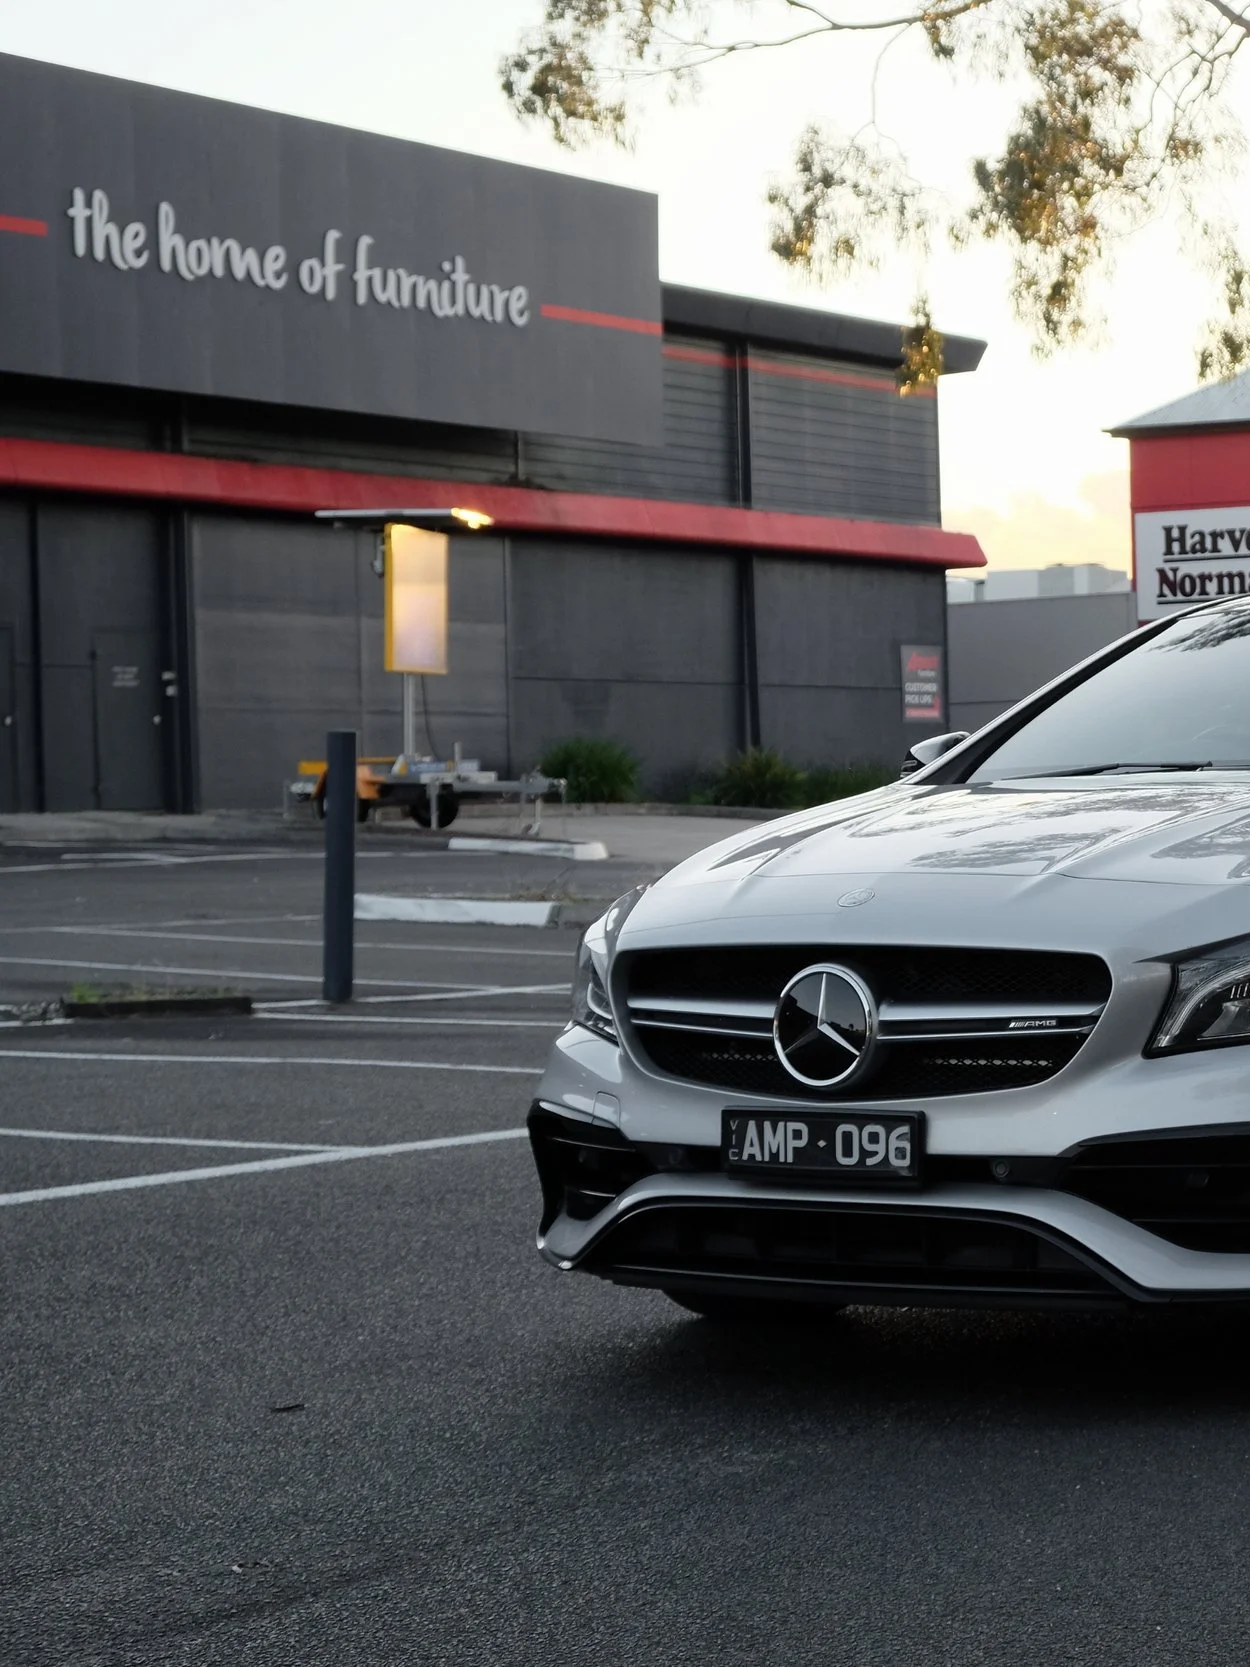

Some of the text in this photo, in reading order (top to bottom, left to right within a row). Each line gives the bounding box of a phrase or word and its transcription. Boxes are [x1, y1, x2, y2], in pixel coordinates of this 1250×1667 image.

[68, 186, 531, 327] the home of furniture
[1023, 1019, 1057, 1028] AMG
[741, 1119, 912, 1167] AMP 096
